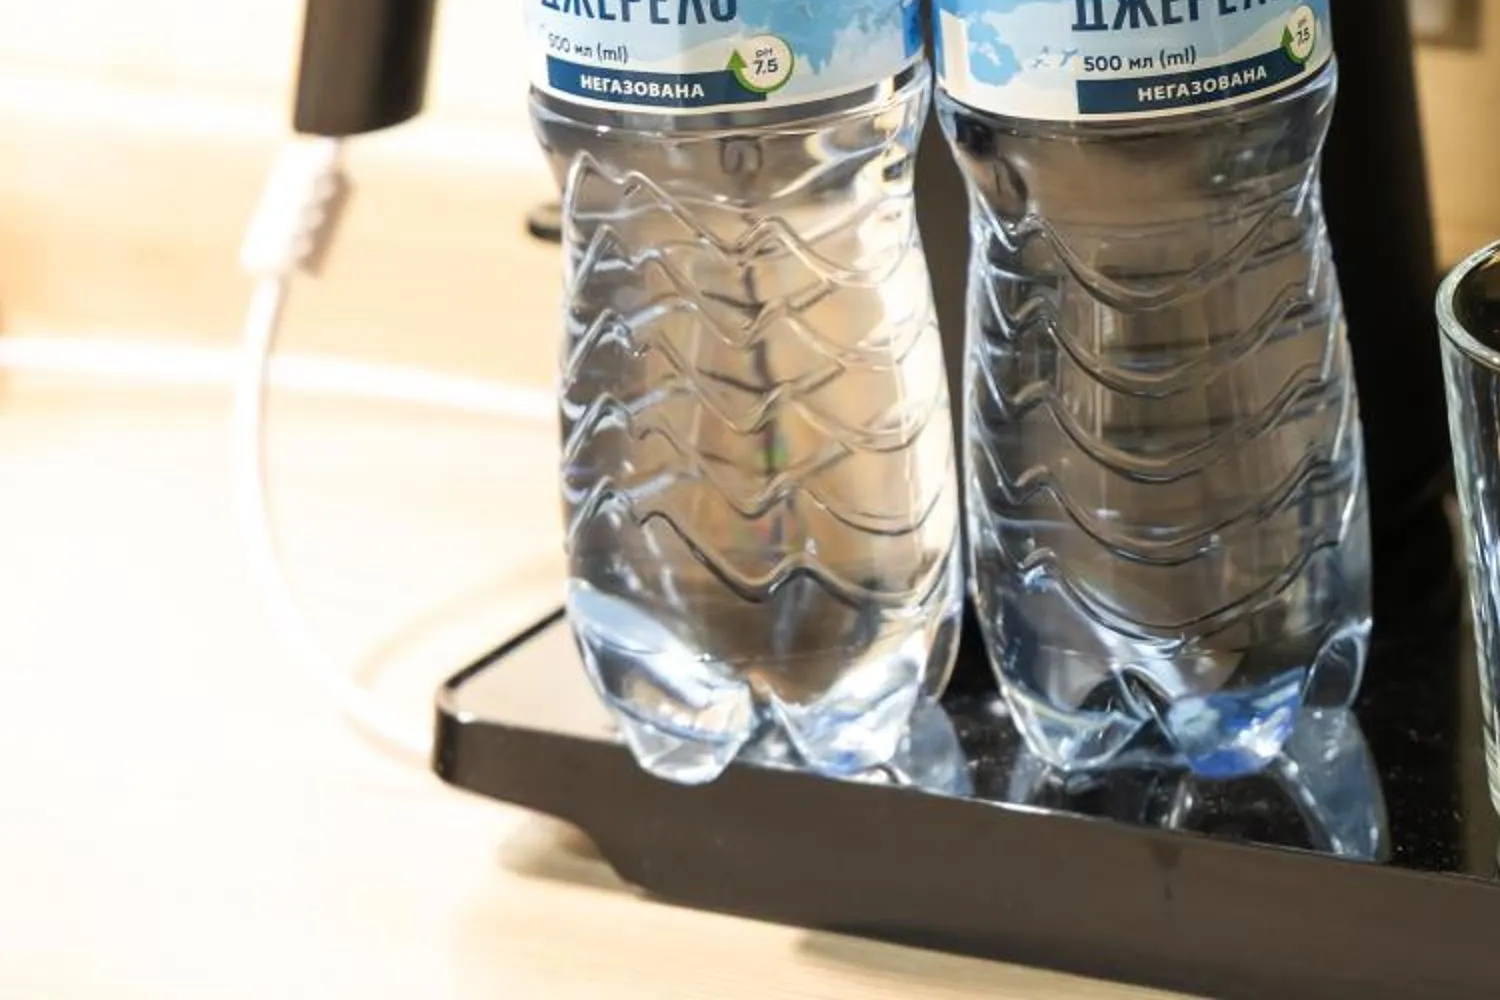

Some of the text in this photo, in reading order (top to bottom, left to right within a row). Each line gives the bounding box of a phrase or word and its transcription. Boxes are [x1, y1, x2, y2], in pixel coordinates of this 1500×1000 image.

[596, 42, 628, 64] (ml)
[1083, 45, 1198, 73] 500 мл (ml)
[580, 74, 705, 98] НЕГАЗОВАНА
[1137, 65, 1268, 103] НЕГАЗОВАНА
